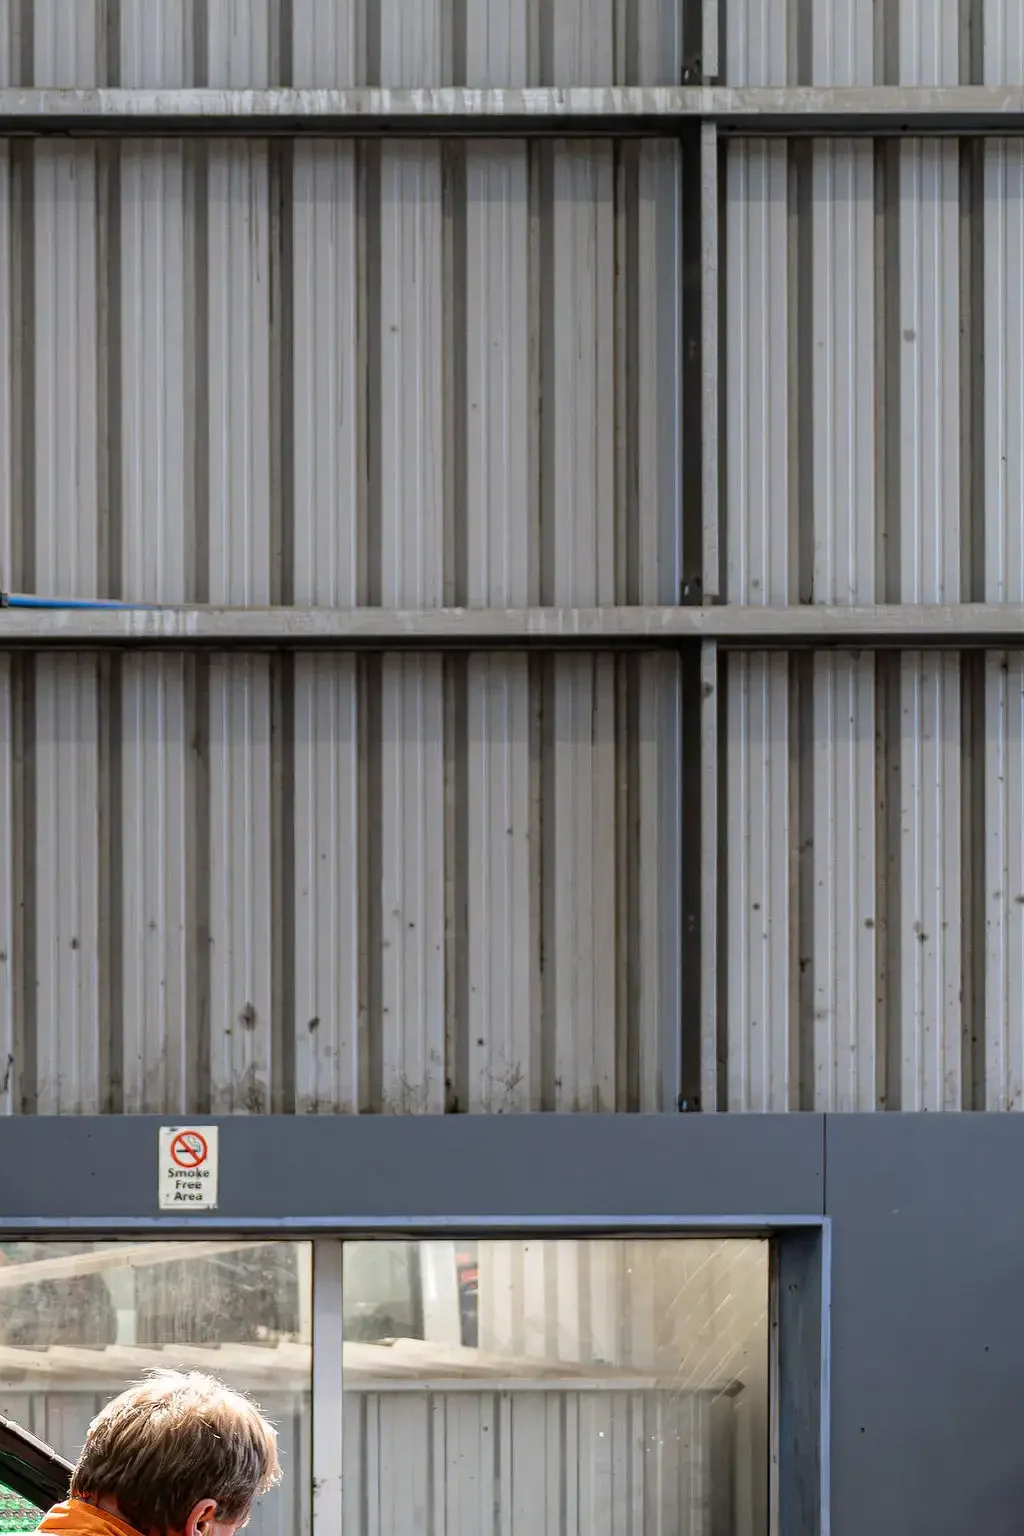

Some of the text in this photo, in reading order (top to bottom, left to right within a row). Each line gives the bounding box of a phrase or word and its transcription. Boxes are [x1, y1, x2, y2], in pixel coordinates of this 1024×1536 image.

[167, 1168, 210, 1178] Smoke
[175, 1180, 203, 1189] Free
[174, 1192, 203, 1201] Area
